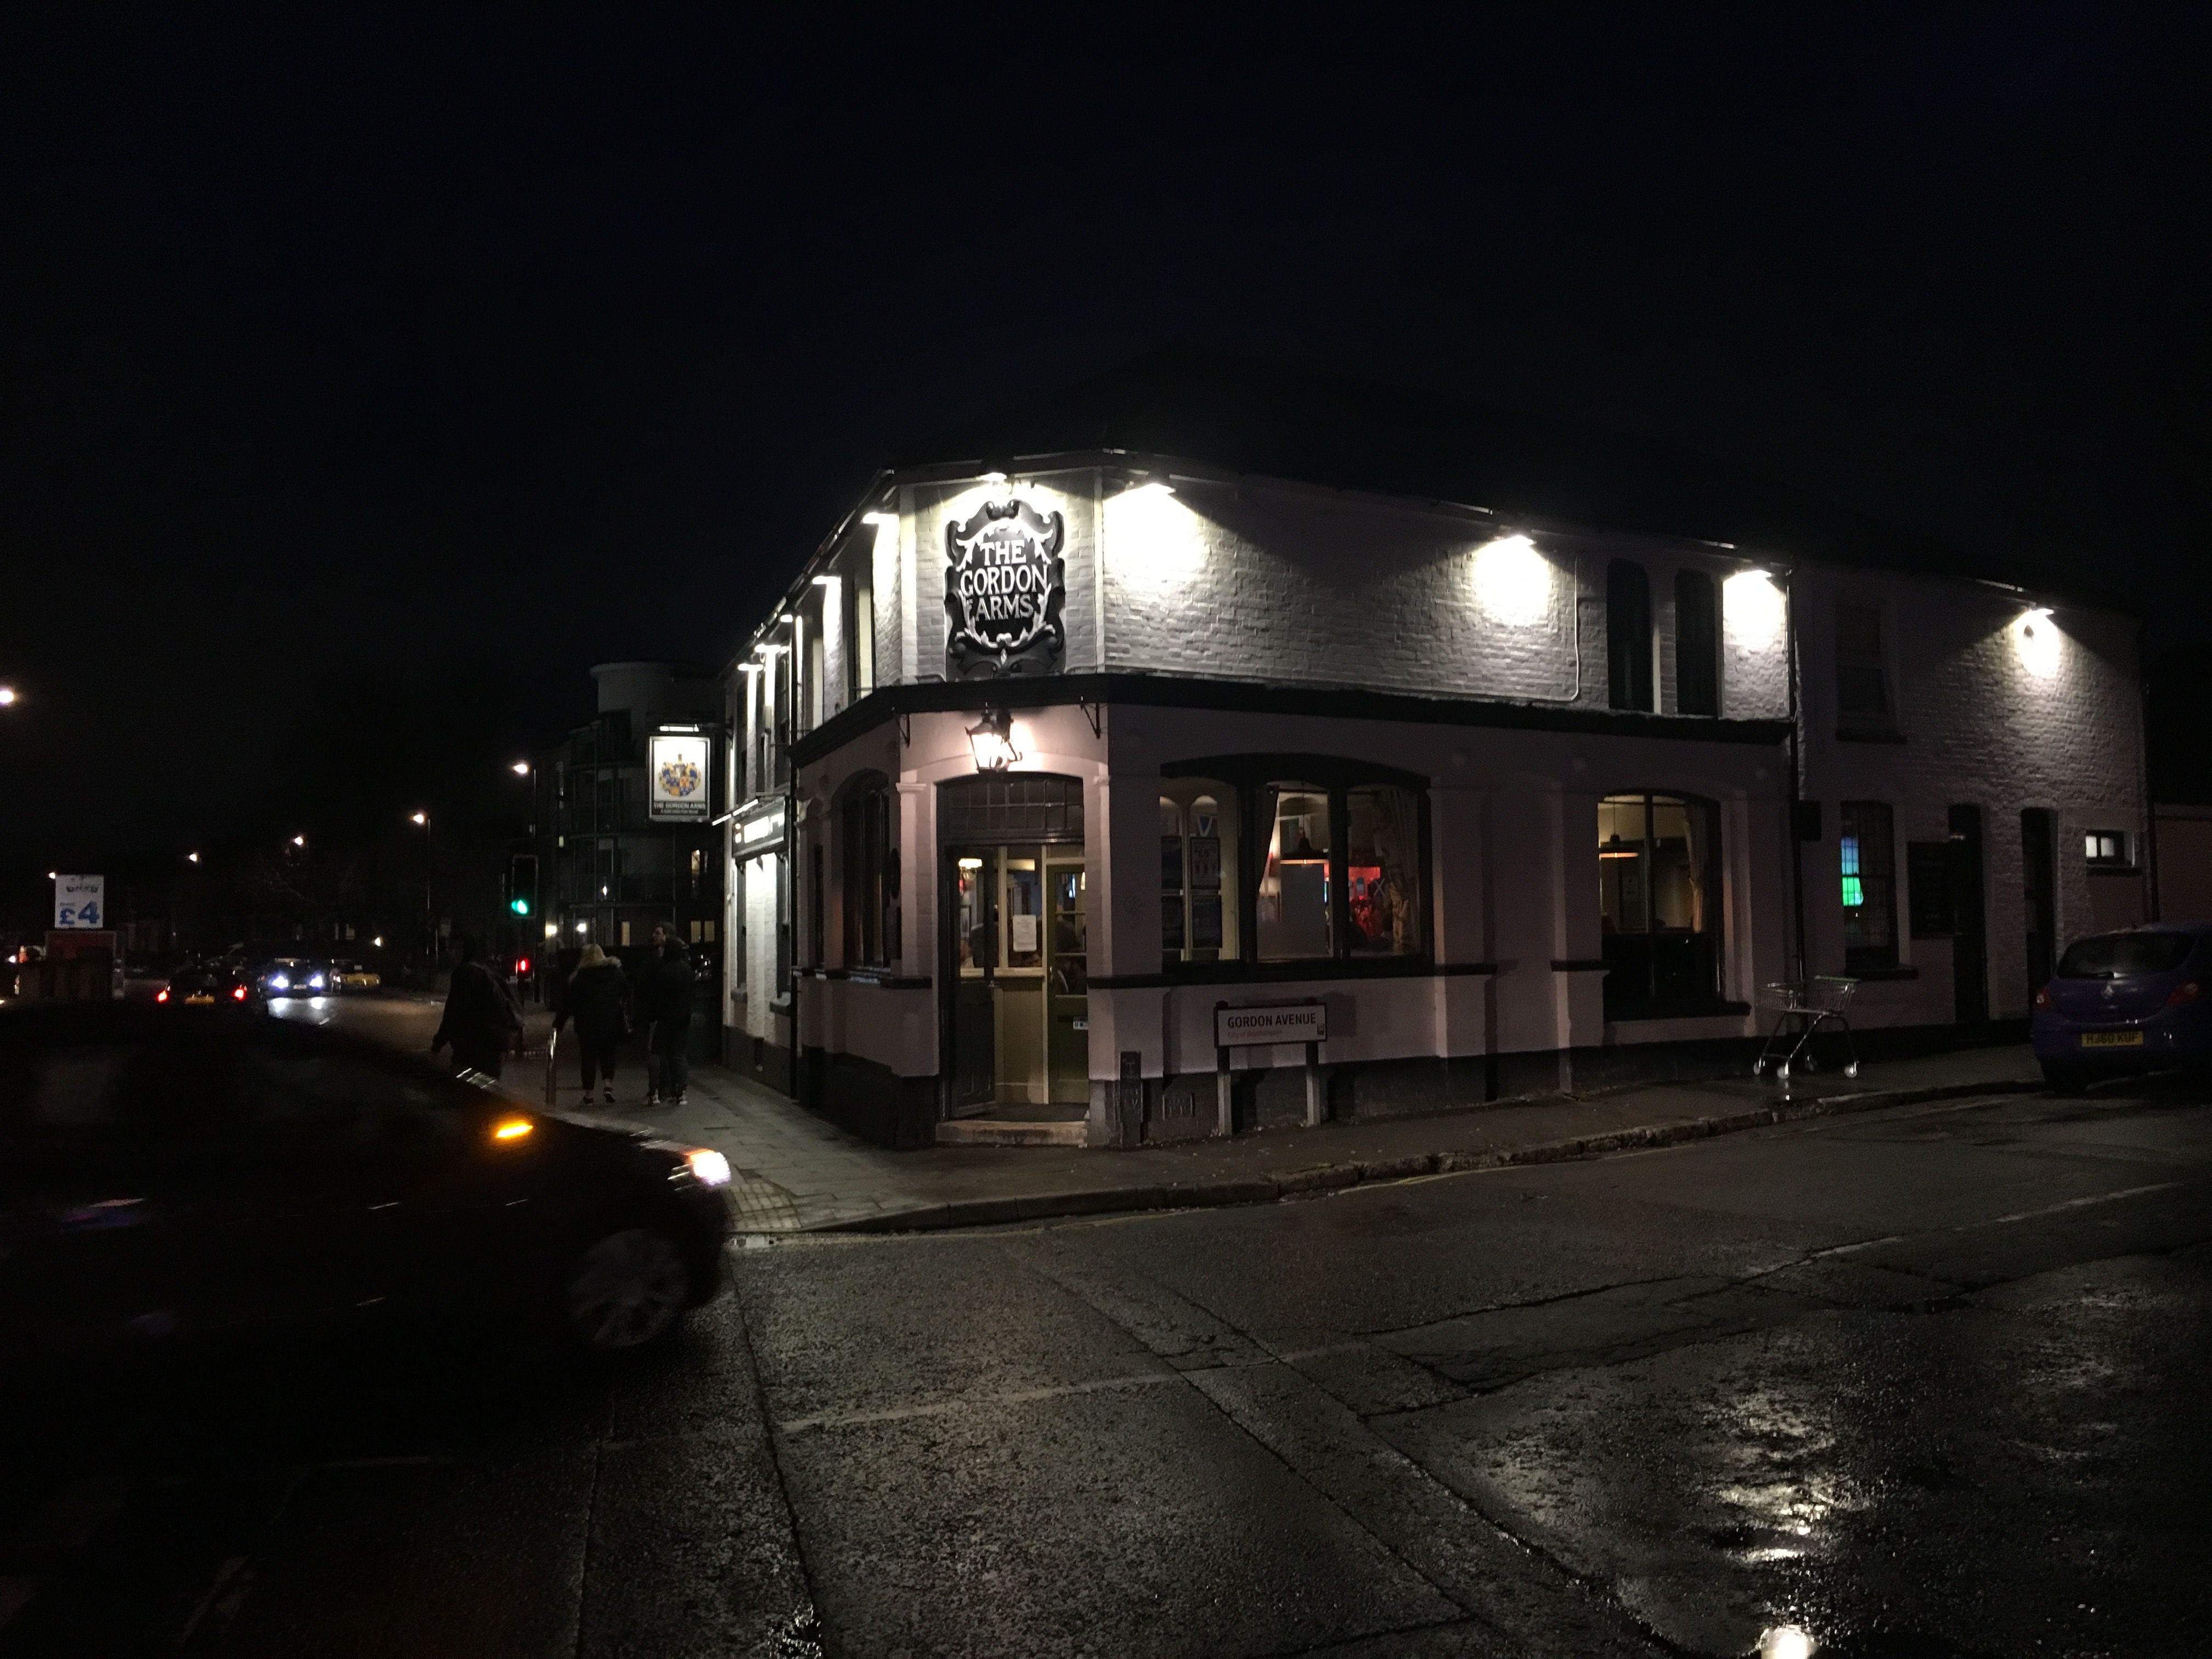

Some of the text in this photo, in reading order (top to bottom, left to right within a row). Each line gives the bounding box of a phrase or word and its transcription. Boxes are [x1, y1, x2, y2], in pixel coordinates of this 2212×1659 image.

[980, 540, 1026, 566] THE
[961, 564, 1048, 597] GORDON
[975, 594, 1035, 621] ARMS
[59, 900, 100, 925] £4
[1228, 1013, 1316, 1028] GORDON AVENUE
